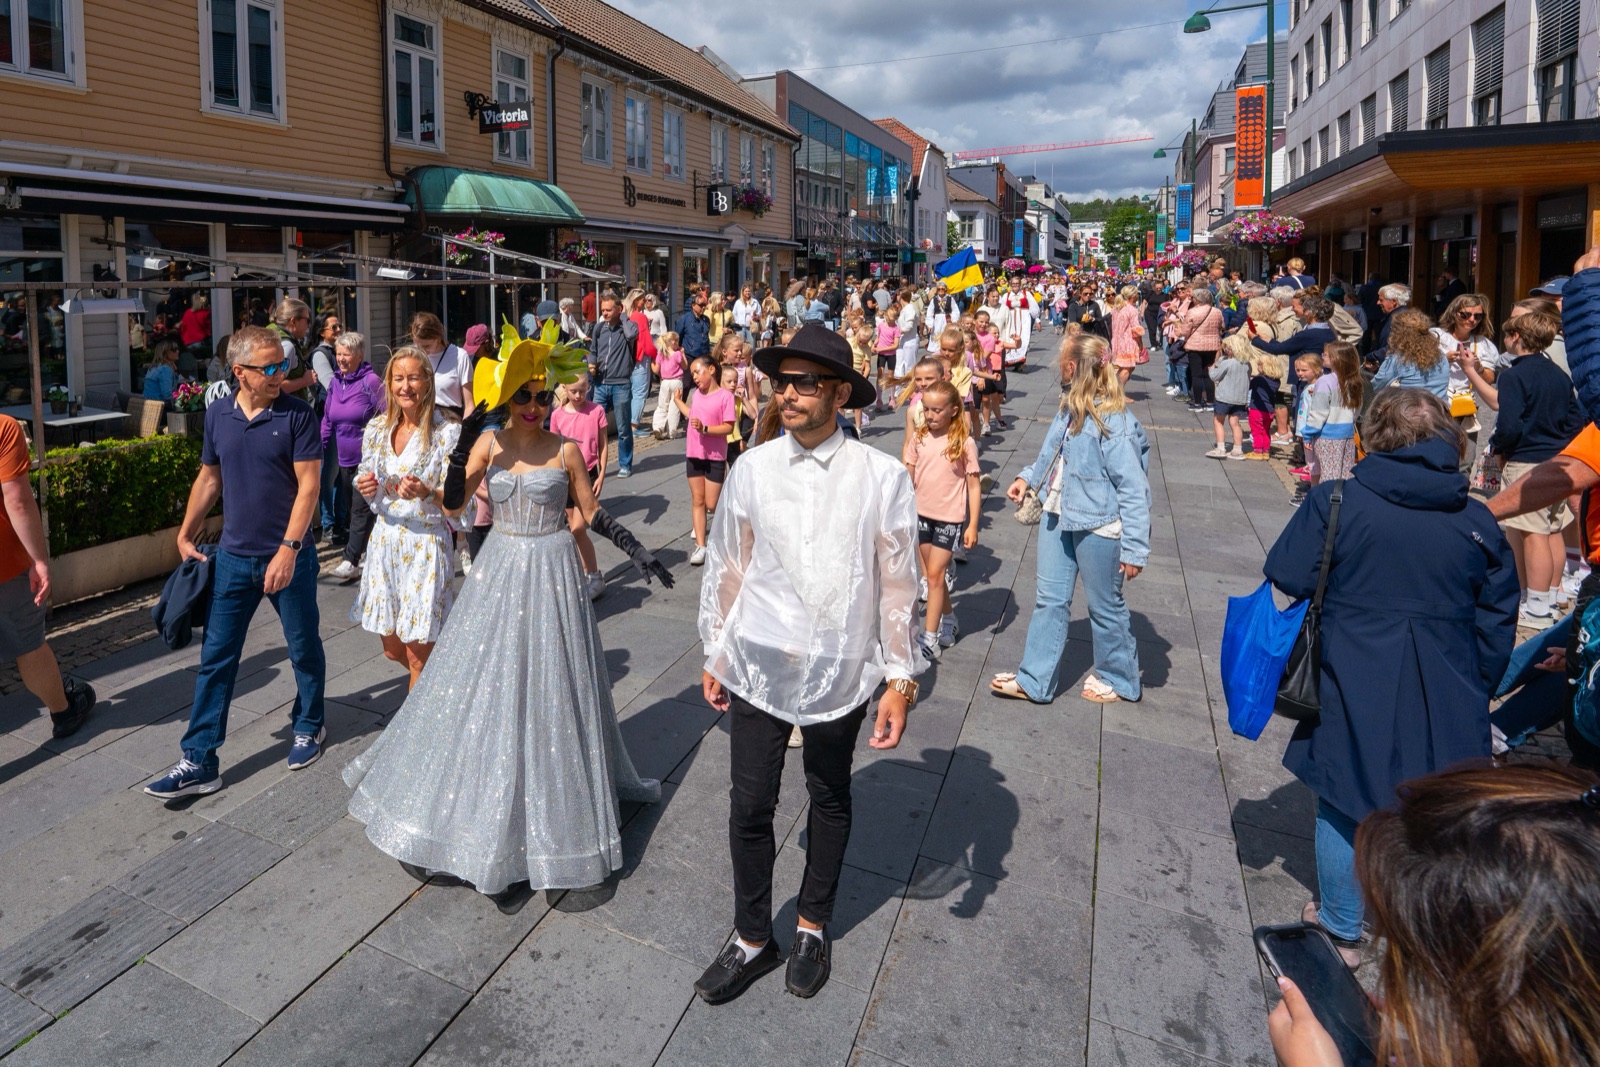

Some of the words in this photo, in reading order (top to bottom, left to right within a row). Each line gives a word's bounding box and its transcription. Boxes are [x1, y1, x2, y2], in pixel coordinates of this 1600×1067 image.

[482, 108, 529, 125] Victoria
[637, 192, 658, 203] BERGES
[657, 196, 687, 208] BOKHANDEL
[712, 191, 728, 212] BB
